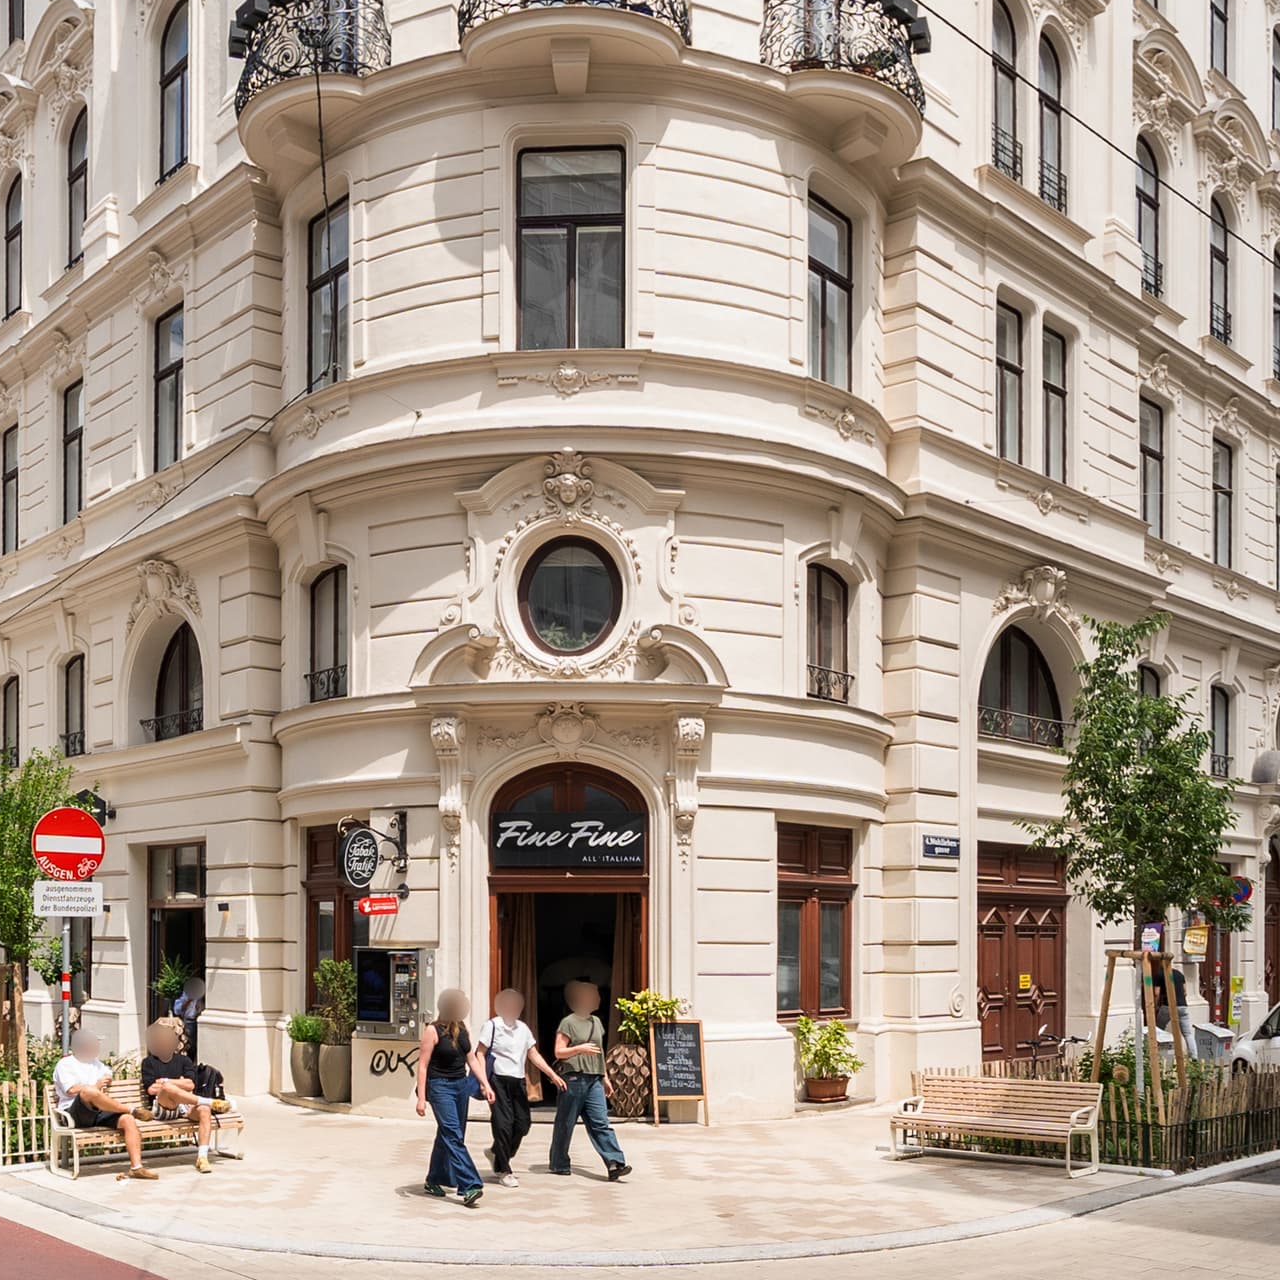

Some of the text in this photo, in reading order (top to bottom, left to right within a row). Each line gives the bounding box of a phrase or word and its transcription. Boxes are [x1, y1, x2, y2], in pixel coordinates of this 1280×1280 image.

[496, 820, 641, 848] Fine Fine
[348, 839, 377, 857] Tabak
[37, 855, 77, 880] AUSGEN.
[348, 858, 376, 874] Trafik
[45, 886, 92, 894] ausgenommen
[42, 894, 95, 904] Dienstfahrzeuge
[40, 904, 97, 913] der Bundespolizei
